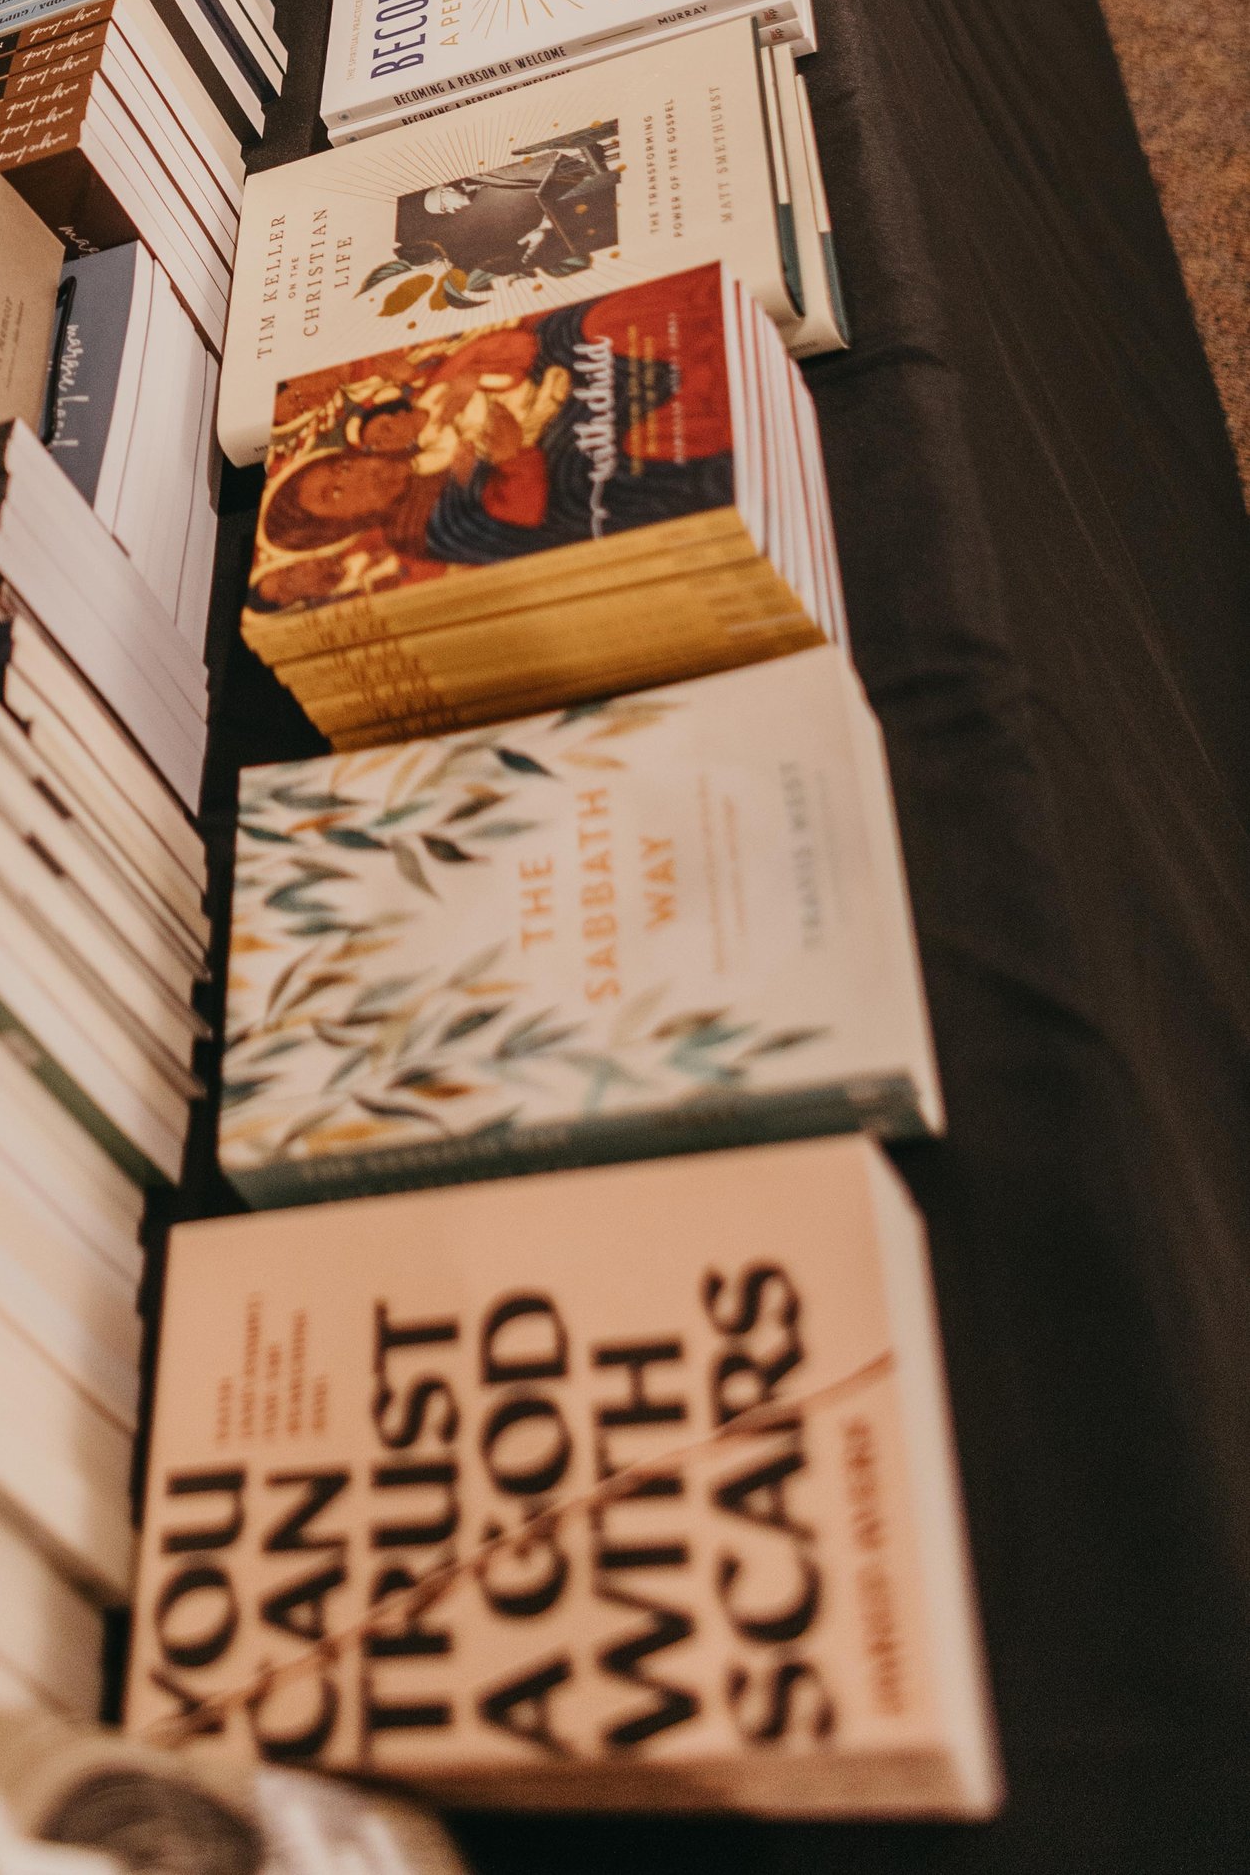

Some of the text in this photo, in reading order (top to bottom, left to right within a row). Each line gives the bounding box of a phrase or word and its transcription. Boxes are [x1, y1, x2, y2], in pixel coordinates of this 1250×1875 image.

[346, 66, 355, 81] THE
[348, 33, 360, 66] SPIRITUAL
[392, 43, 568, 109] BECOMING A PERSON OF WELCOME
[440, 32, 459, 45] A
[656, 1, 710, 28] MURRAY
[644, 116, 659, 234] THE TRANSFORMING
[664, 99, 683, 238] POWER OF THE GOSPEL
[709, 87, 733, 222] MATT SMETHURST
[257, 215, 285, 359] TIM KELLER
[288, 257, 299, 299] ON THE
[304, 208, 327, 336] CHRISTIAN
[334, 237, 352, 288] LIFE
[519, 857, 556, 955] THE
[575, 787, 622, 1005] SABBATH
[640, 835, 682, 935] WAY
[360, 1297, 461, 1762] TRUST
[477, 1286, 572, 1763] A GOD
[594, 1337, 698, 1755] WITH
[705, 1257, 840, 1752] SCARS
[146, 1463, 246, 1733] YOU
[248, 1465, 350, 1763] CAN
